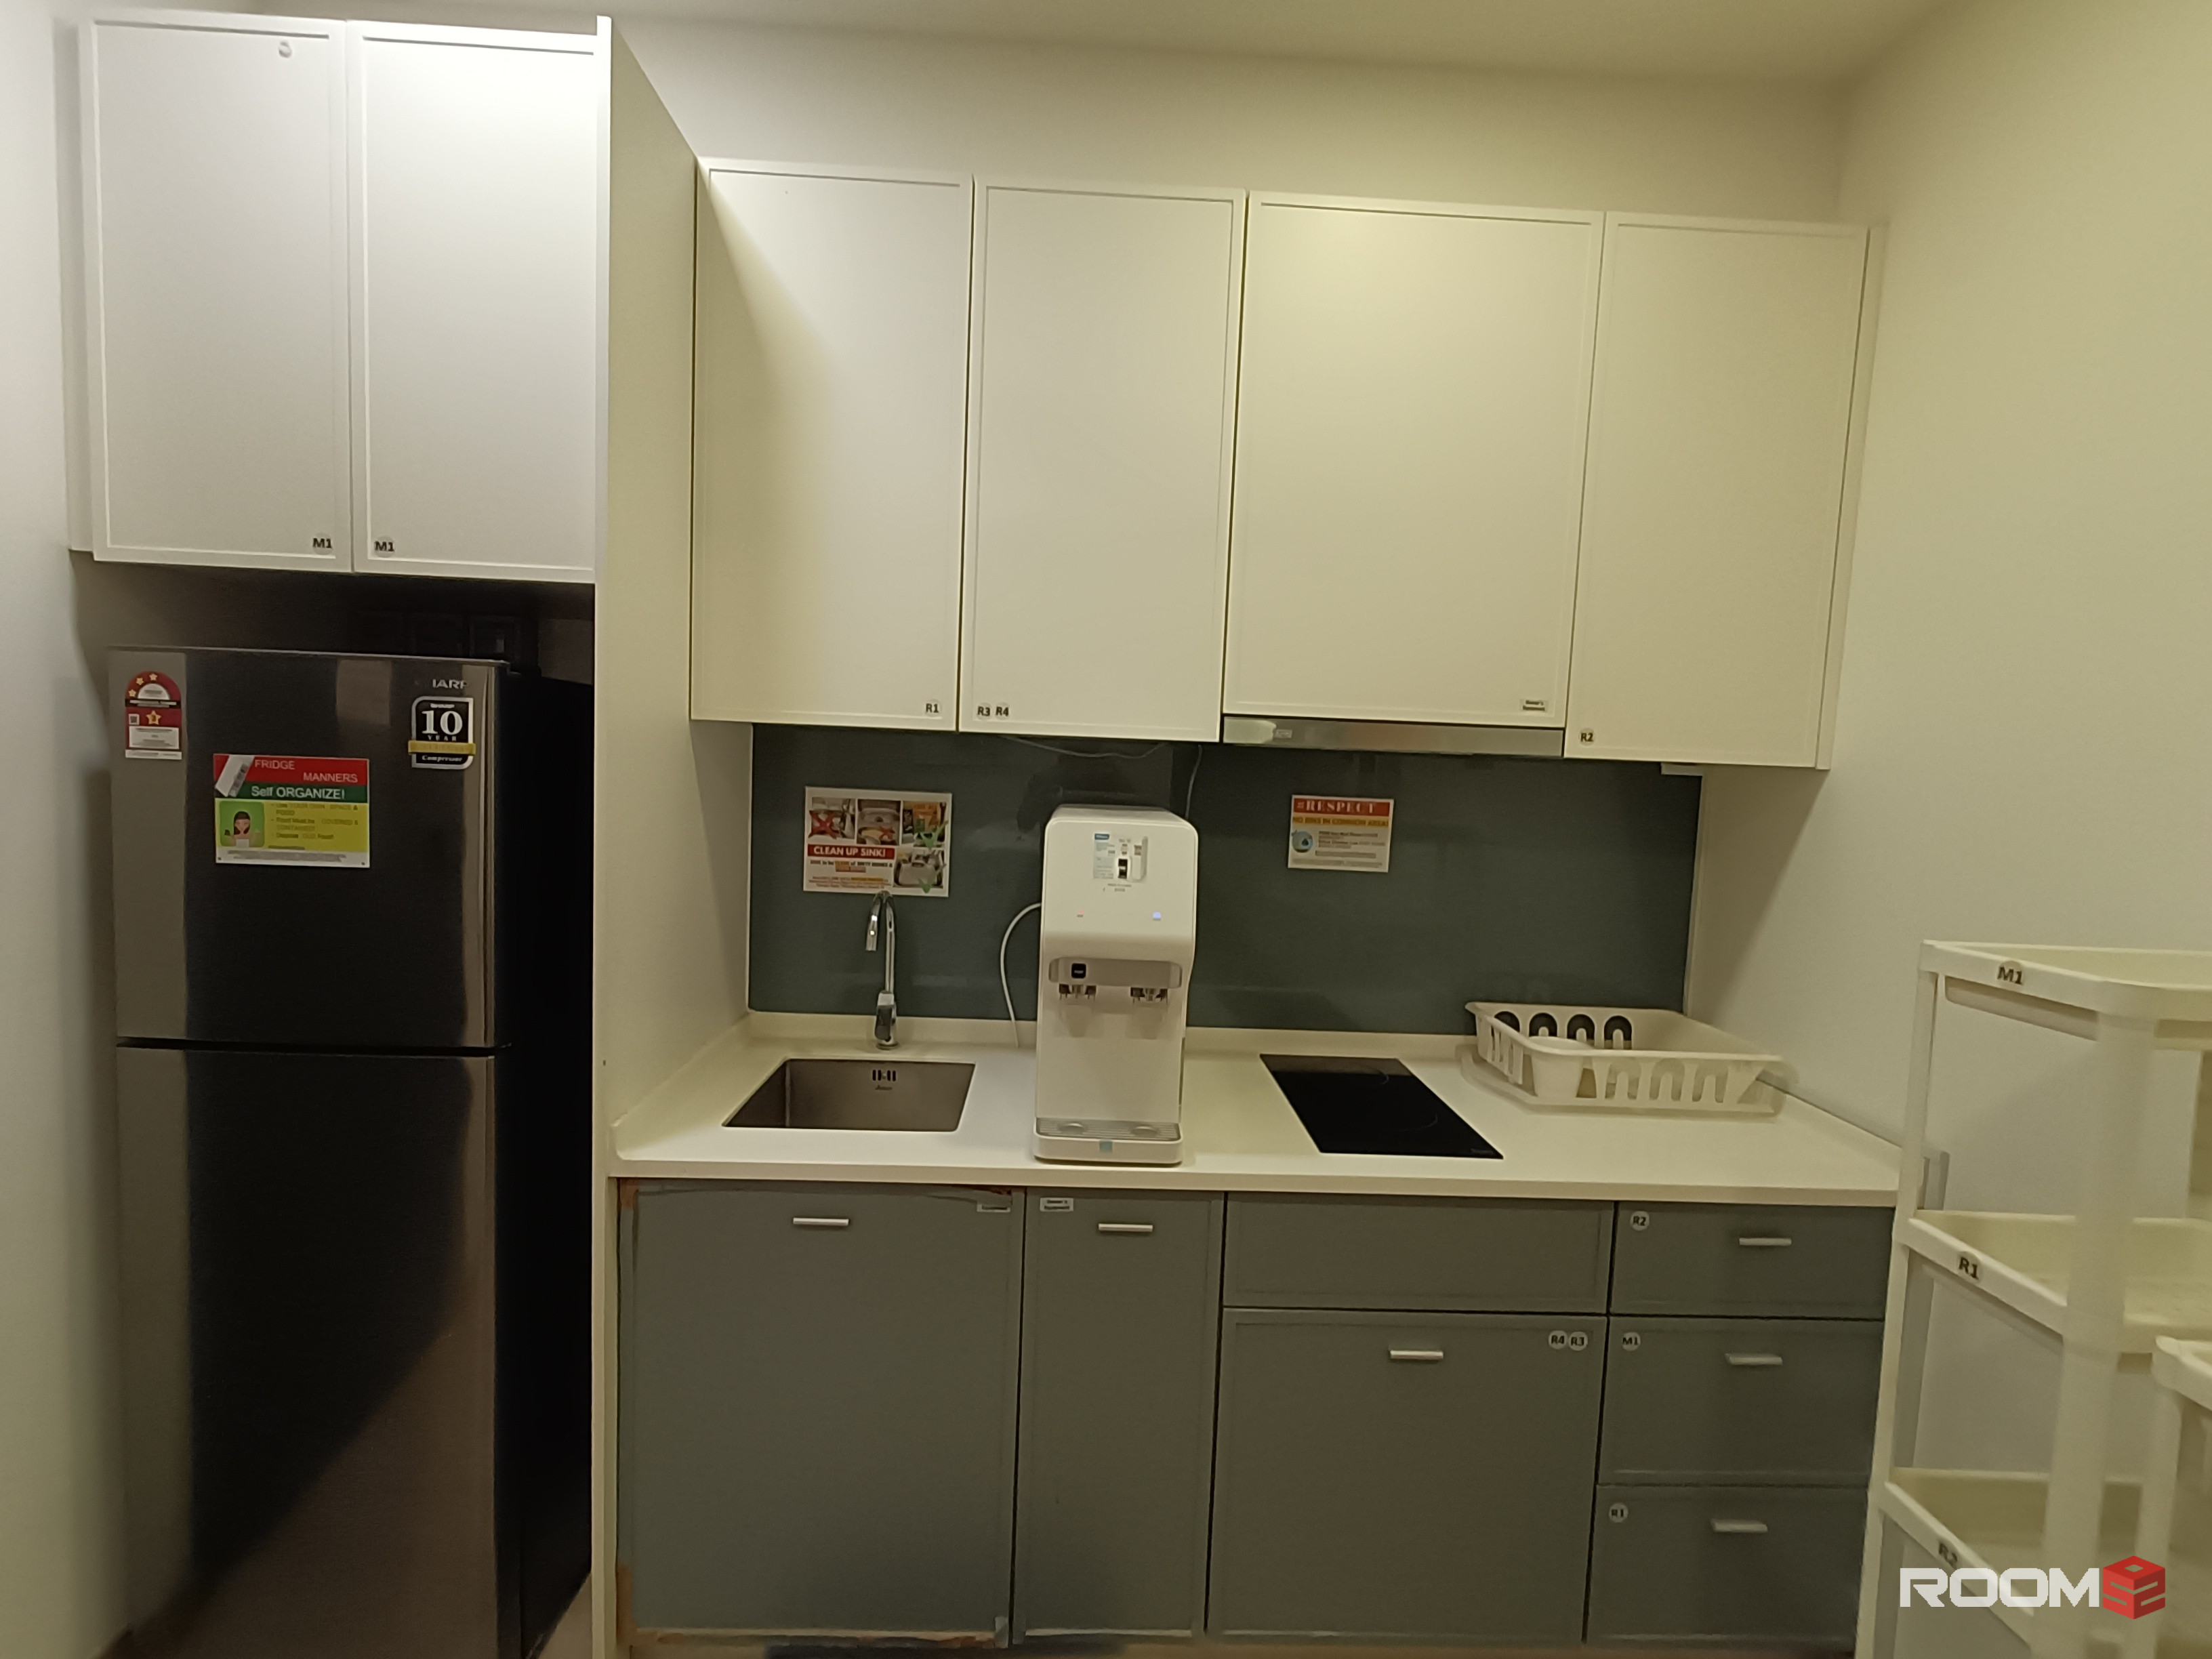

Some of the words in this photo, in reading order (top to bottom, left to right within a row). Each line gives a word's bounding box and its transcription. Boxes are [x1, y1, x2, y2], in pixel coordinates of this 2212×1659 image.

[312, 537, 332, 549] M1
[374, 541, 395, 552] M1
[926, 703, 939, 714] R1
[977, 705, 991, 716] R3
[996, 706, 1009, 717] R4
[422, 710, 463, 735] 10
[1580, 732, 1595, 743] R2
[254, 759, 295, 771] FRIDGE
[303, 771, 359, 783] MANNERS
[251, 785, 272, 797] Self
[276, 786, 346, 800] ORGANIZE!
[1305, 800, 1376, 814] RESPECT
[813, 846, 844, 856] CLEAN
[846, 846, 859, 855] UP
[861, 847, 886, 857] SINK!
[1996, 966, 2023, 985] M1
[1633, 1215, 1647, 1227] R2
[1958, 1256, 1979, 1280] R1
